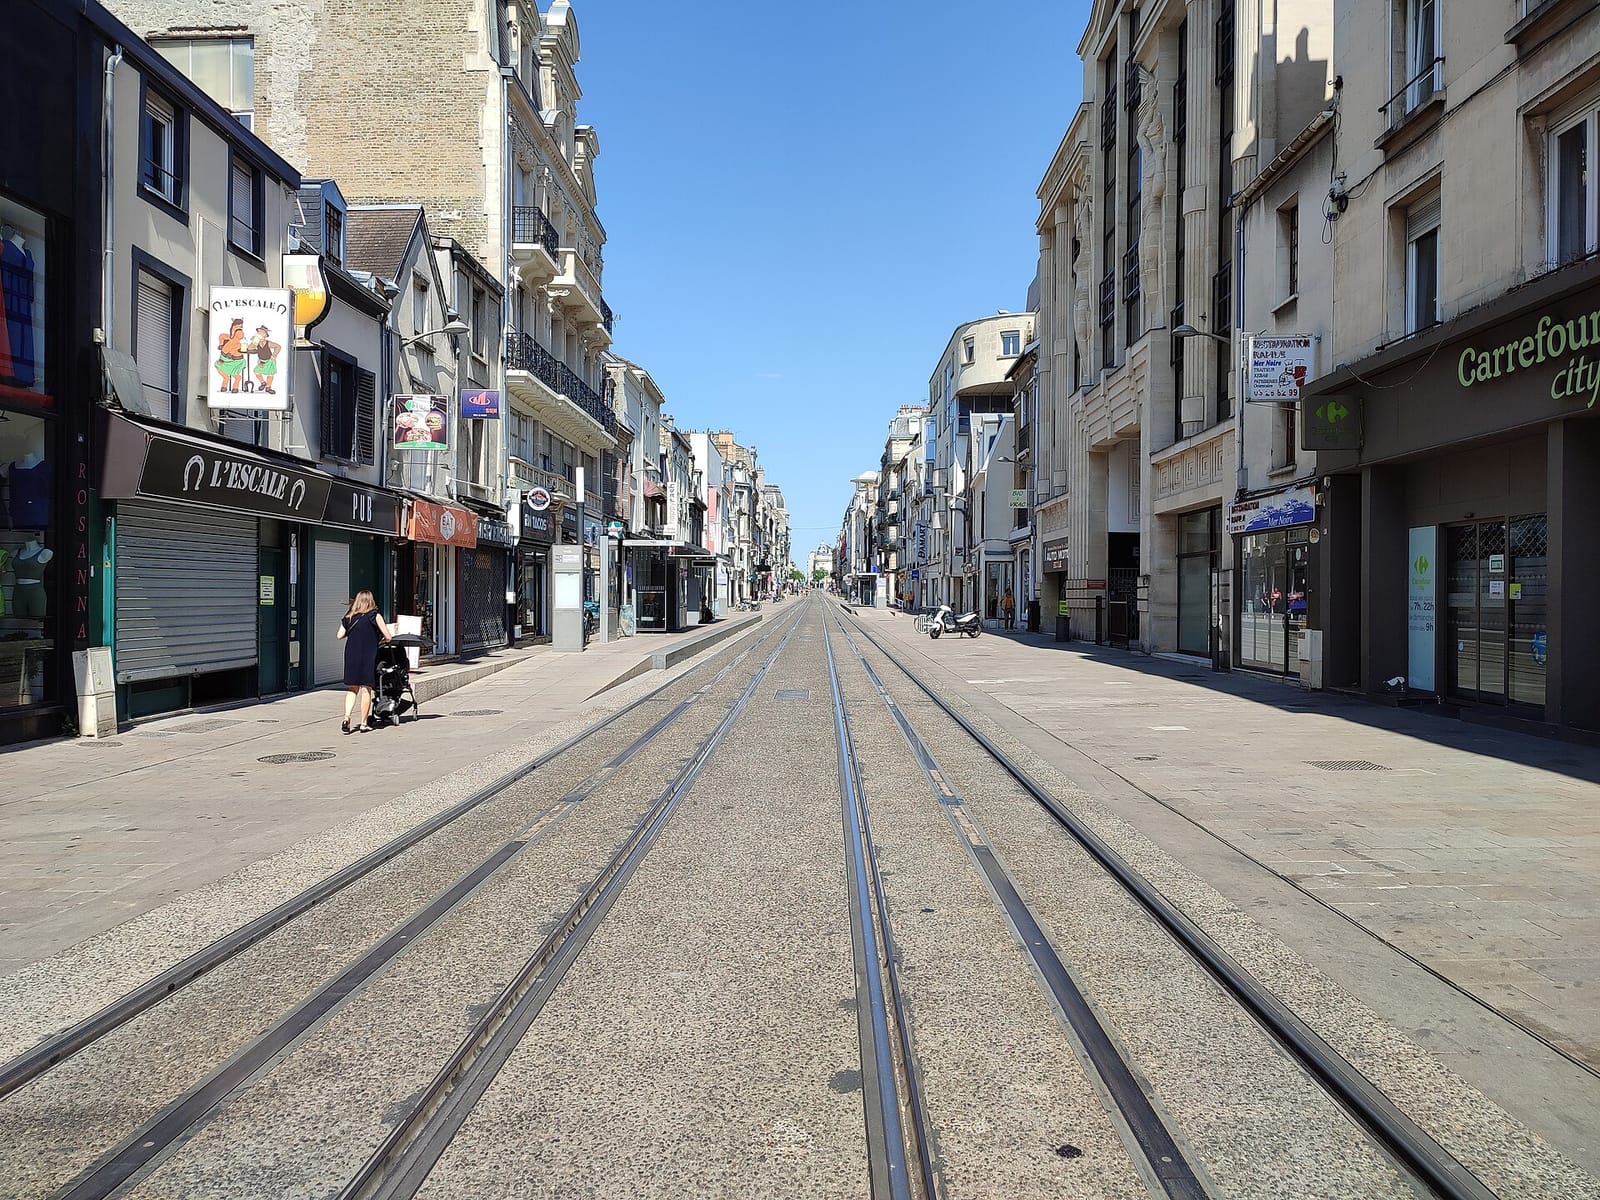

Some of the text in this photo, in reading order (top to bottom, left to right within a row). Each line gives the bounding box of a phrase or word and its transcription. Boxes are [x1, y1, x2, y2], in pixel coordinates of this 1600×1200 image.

[224, 299, 277, 311] L'ESCALE
[1265, 359, 1282, 367] Noire
[1550, 355, 1600, 409] city
[209, 460, 290, 501] L'ESCALE
[352, 492, 373, 523] PUB
[77, 462, 88, 639] ROSANNA
